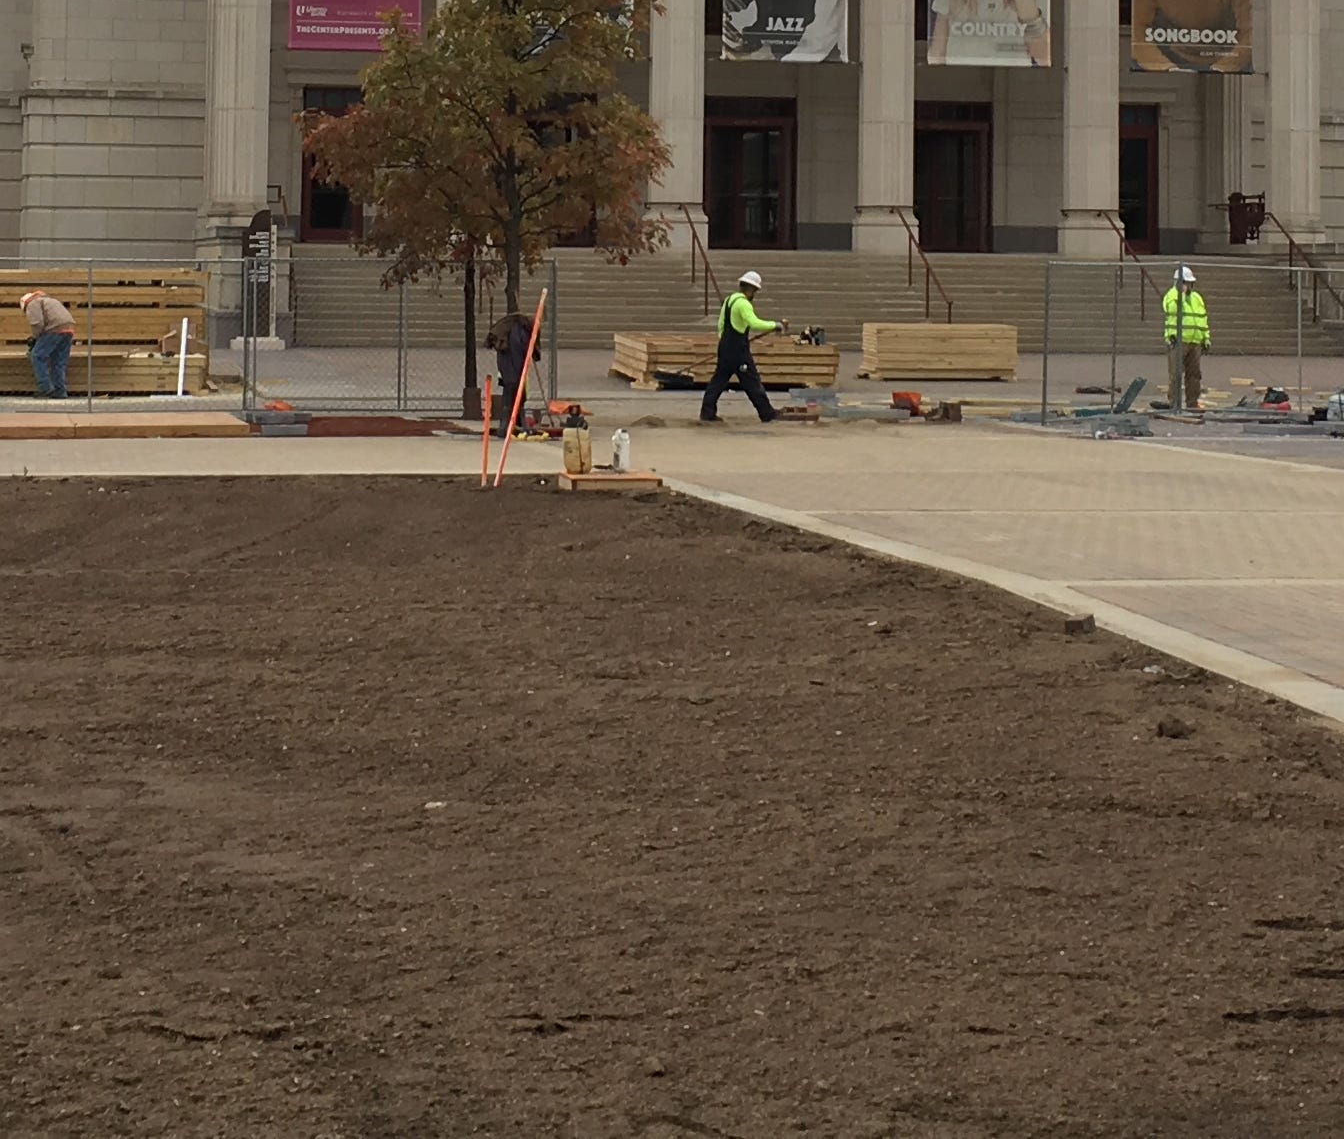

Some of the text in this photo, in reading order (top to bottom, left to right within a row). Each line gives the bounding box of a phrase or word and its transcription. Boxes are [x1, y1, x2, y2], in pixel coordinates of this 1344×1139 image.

[766, 17, 804, 31] JAZZ
[951, 21, 1028, 37] COUNTRY
[1144, 27, 1239, 44] SONGBOOK
